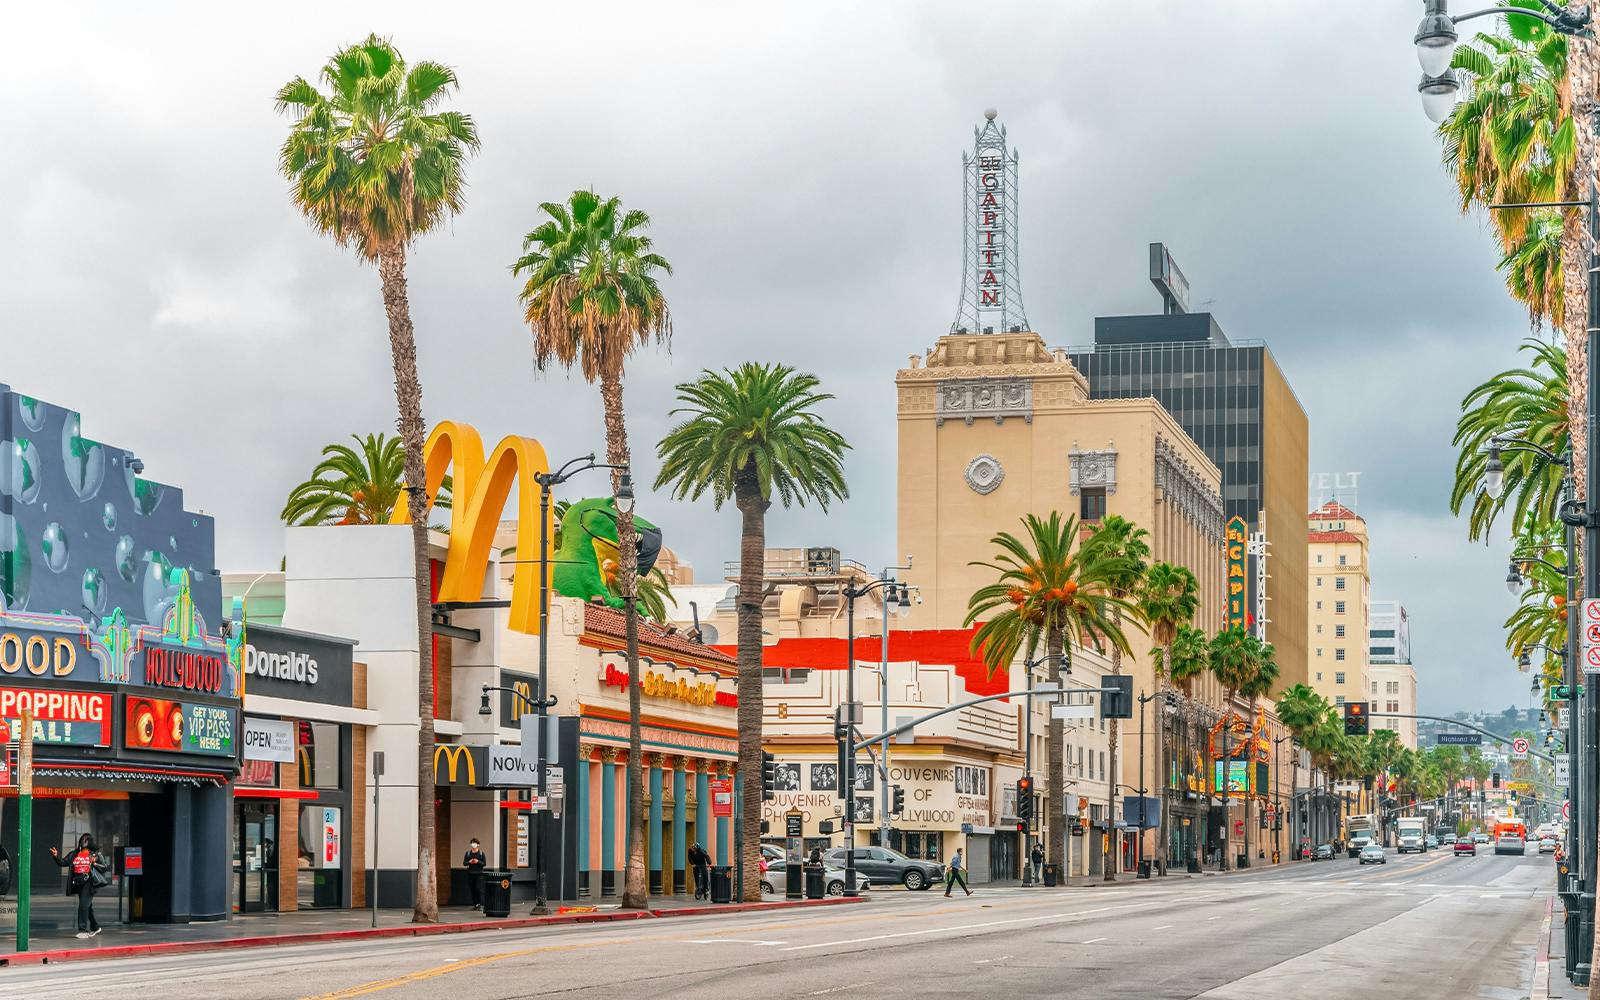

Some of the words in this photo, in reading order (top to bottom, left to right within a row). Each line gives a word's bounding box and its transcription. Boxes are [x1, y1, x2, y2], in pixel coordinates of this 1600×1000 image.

[980, 173, 999, 306] CAPITAN
[1228, 529, 1244, 543] EL
[0, 632, 76, 676] OOD
[146, 647, 222, 692] HOLLYWOOD
[245, 643, 319, 684] Donald's
[1, 690, 103, 720] POPPING
[193, 706, 206, 718] GET
[208, 708, 228, 719] YOUR
[189, 717, 205, 736] VIP
[206, 720, 231, 739] PASS
[199, 737, 220, 750] HERE
[245, 730, 272, 748] OPEN
[1441, 736, 1468, 744] Highland
[493, 756, 526, 772] NOW
[763, 794, 831, 807] OUVENIRS
[914, 789, 933, 801] OF
